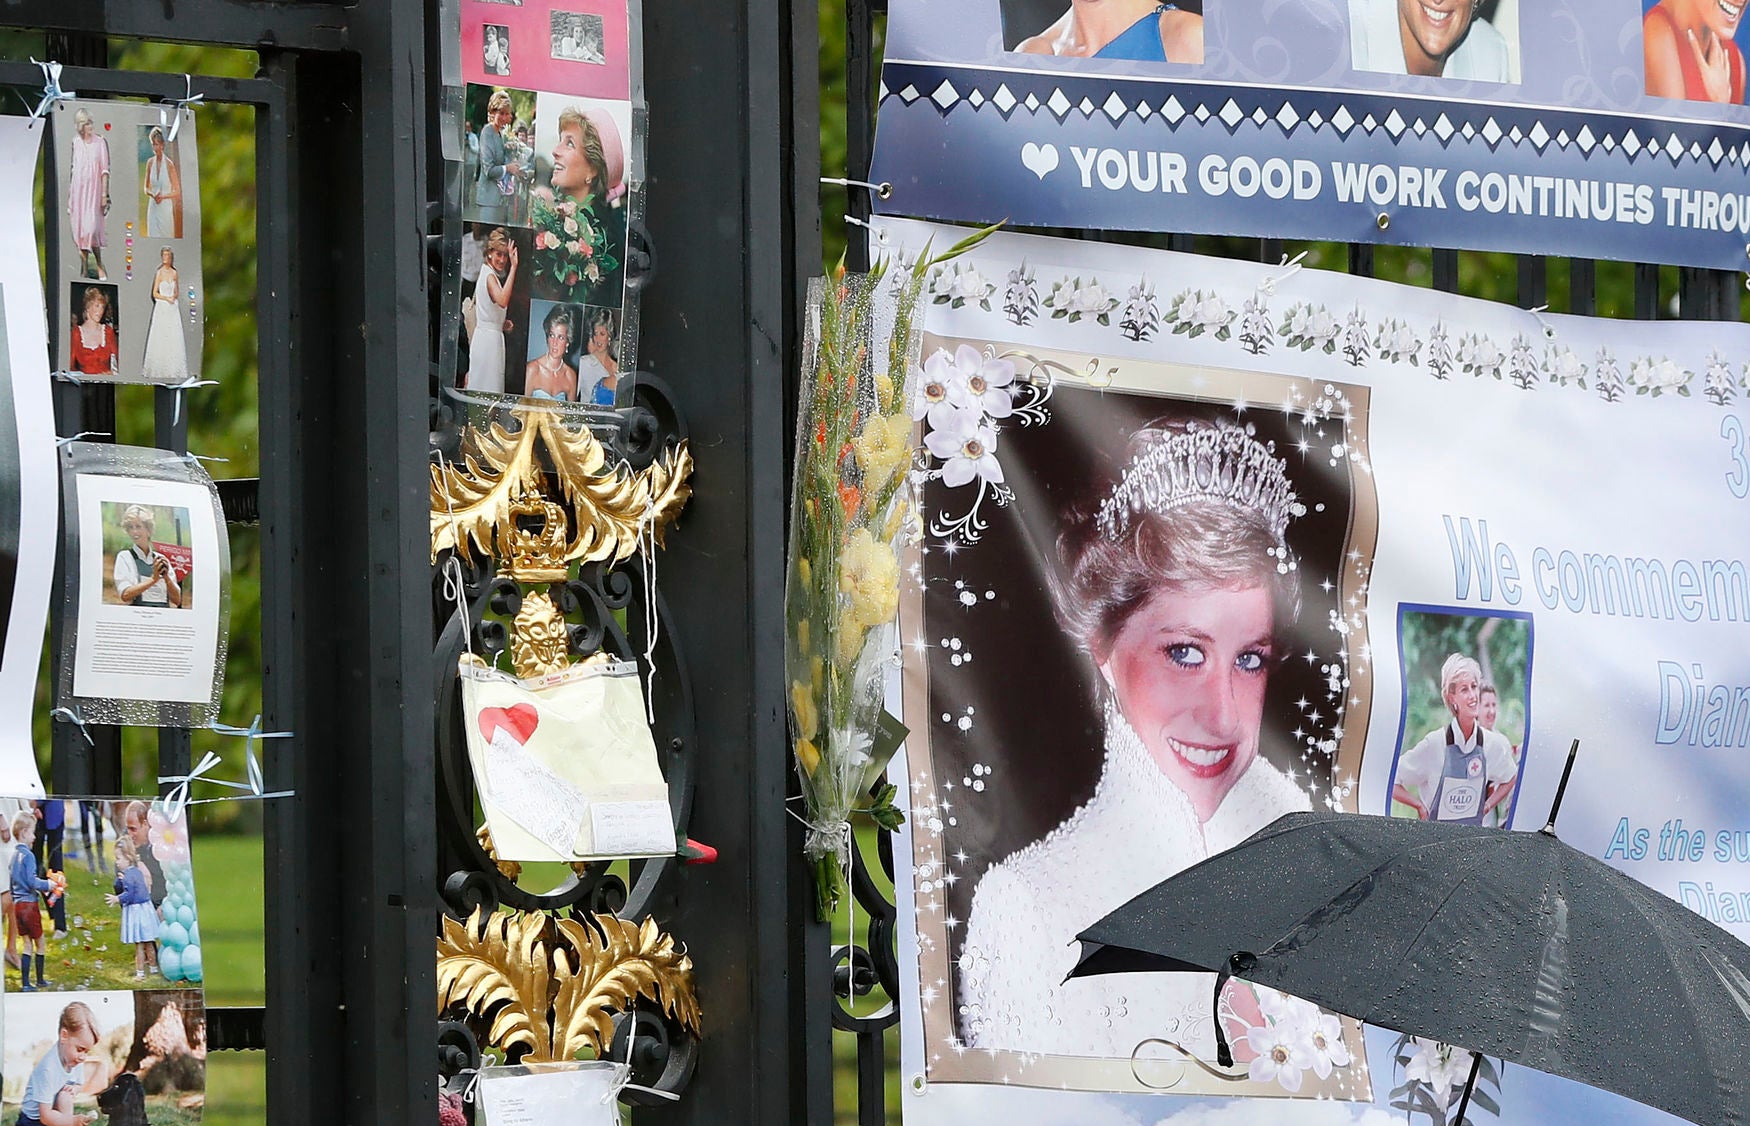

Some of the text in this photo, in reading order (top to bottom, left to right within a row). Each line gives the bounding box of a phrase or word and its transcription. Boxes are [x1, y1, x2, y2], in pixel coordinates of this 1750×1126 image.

[1070, 145, 1188, 195] YOUR
[1198, 153, 1323, 202] GOOD
[1331, 162, 1446, 210] WORK
[1455, 173, 1654, 225] CONTINUES
[1443, 513, 1524, 606] We
[1449, 795, 1473, 804] HALO
[1604, 817, 1648, 860] As
[1656, 818, 1706, 862] the
